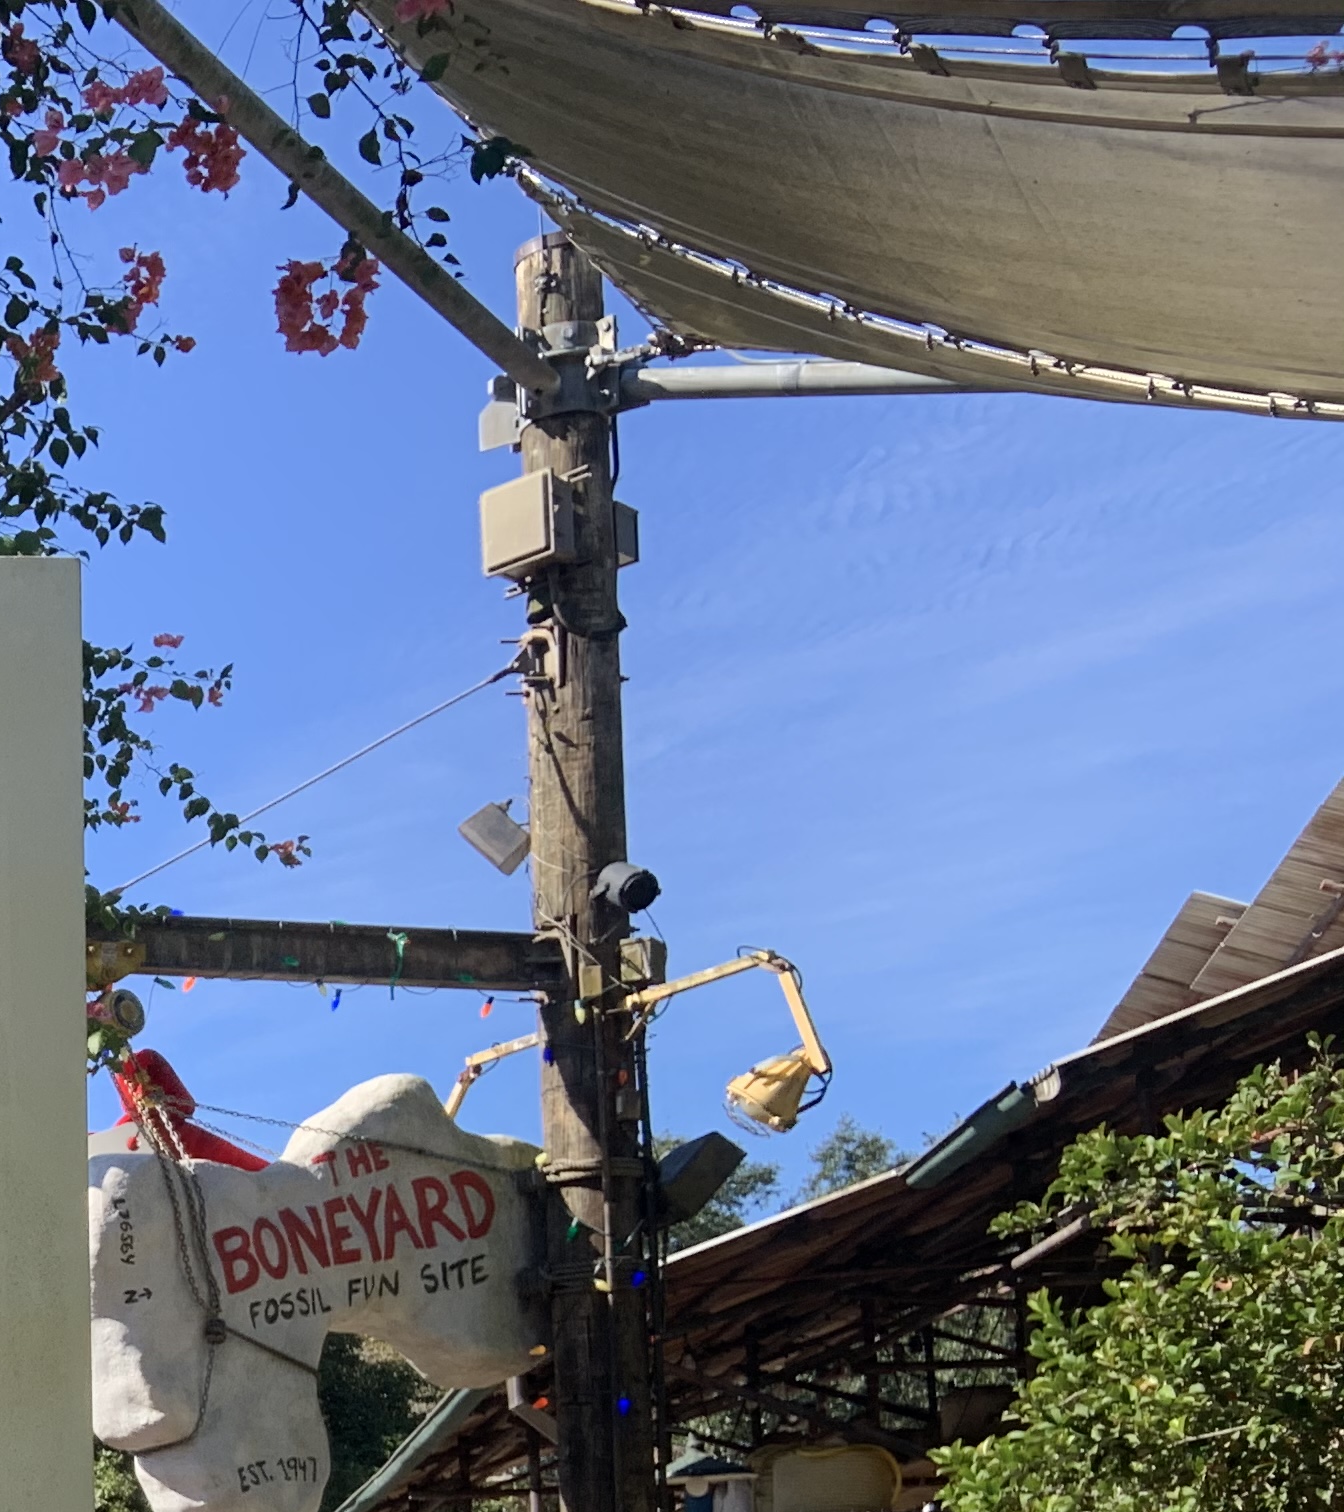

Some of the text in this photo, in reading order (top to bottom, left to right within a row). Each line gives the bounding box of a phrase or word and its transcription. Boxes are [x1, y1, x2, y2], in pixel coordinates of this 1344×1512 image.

[310, 1142, 391, 1187] THE
[213, 1169, 496, 1295] BONEYARD
[249, 1253, 490, 1329] FOSSIL FUN SITE
[237, 1456, 317, 1493] EST. 1947
